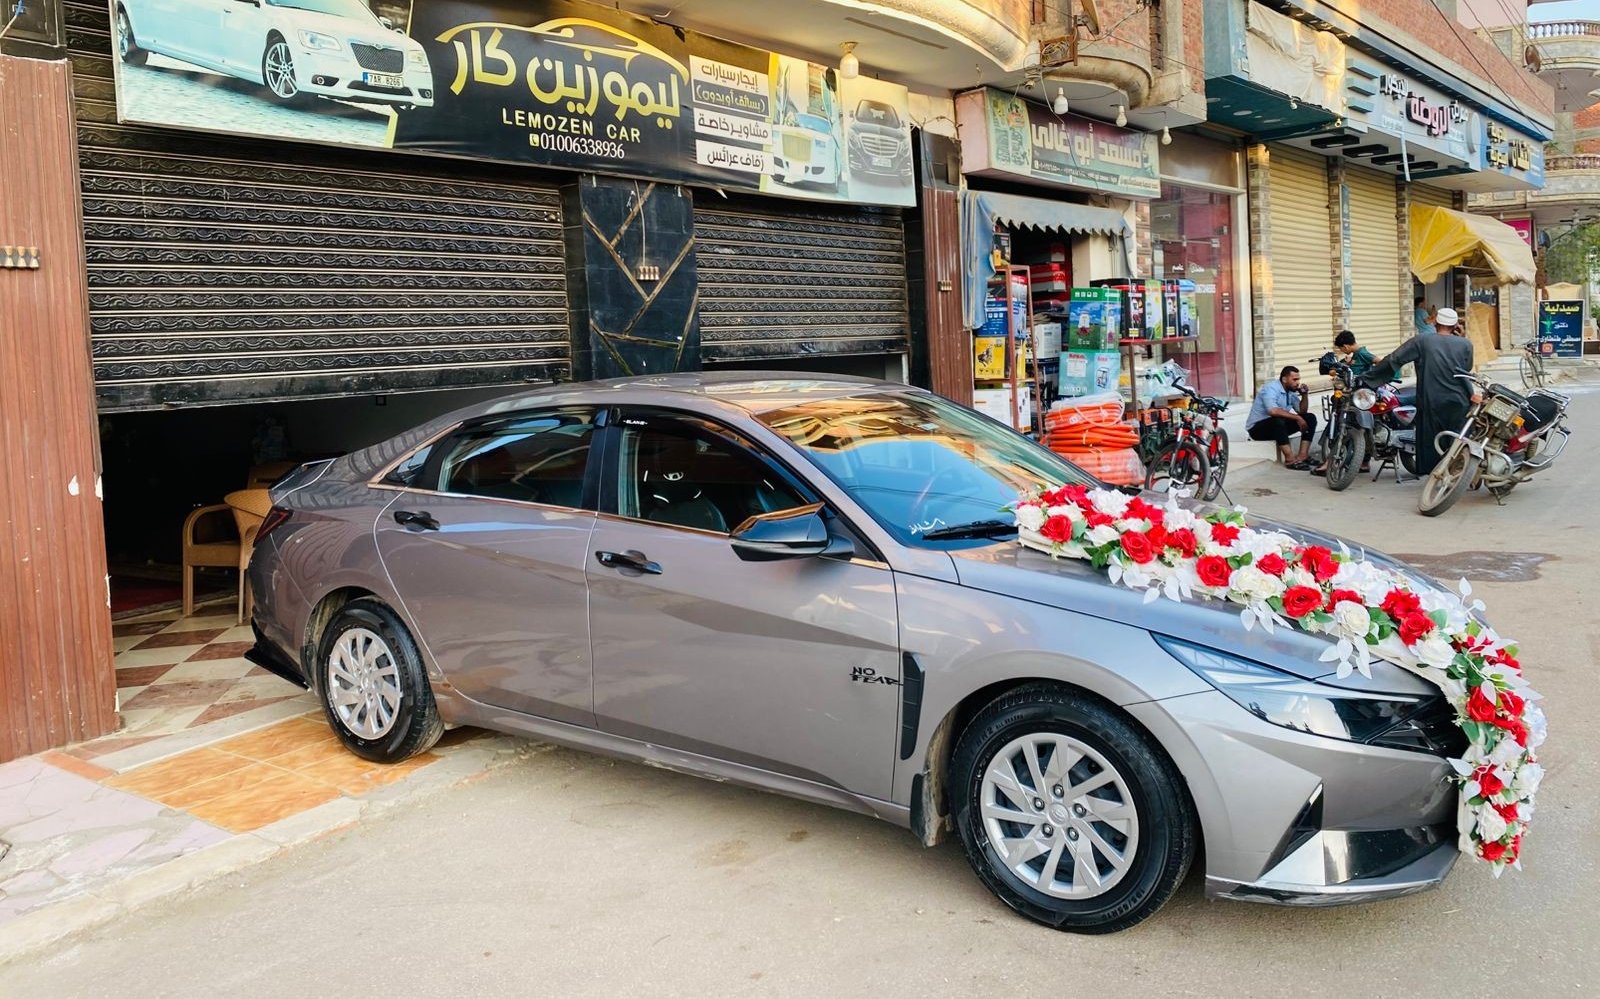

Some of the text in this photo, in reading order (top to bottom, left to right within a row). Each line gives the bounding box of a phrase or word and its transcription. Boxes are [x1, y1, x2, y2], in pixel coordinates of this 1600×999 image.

[450, 28, 681, 130] ليموزين كار
[701, 64, 759, 93] إيجار سيارات
[502, 108, 641, 143] LEMOZEN CAR
[697, 112, 769, 140] مشاوير خاصة
[540, 132, 625, 159] 01006338936
[1074, 123, 1095, 165] أبو
[1098, 142, 1142, 168] مسعد
[707, 148, 764, 171] زفاف عرائس
[1544, 302, 1580, 315] صيدلية
[852, 665, 876, 676] NO
